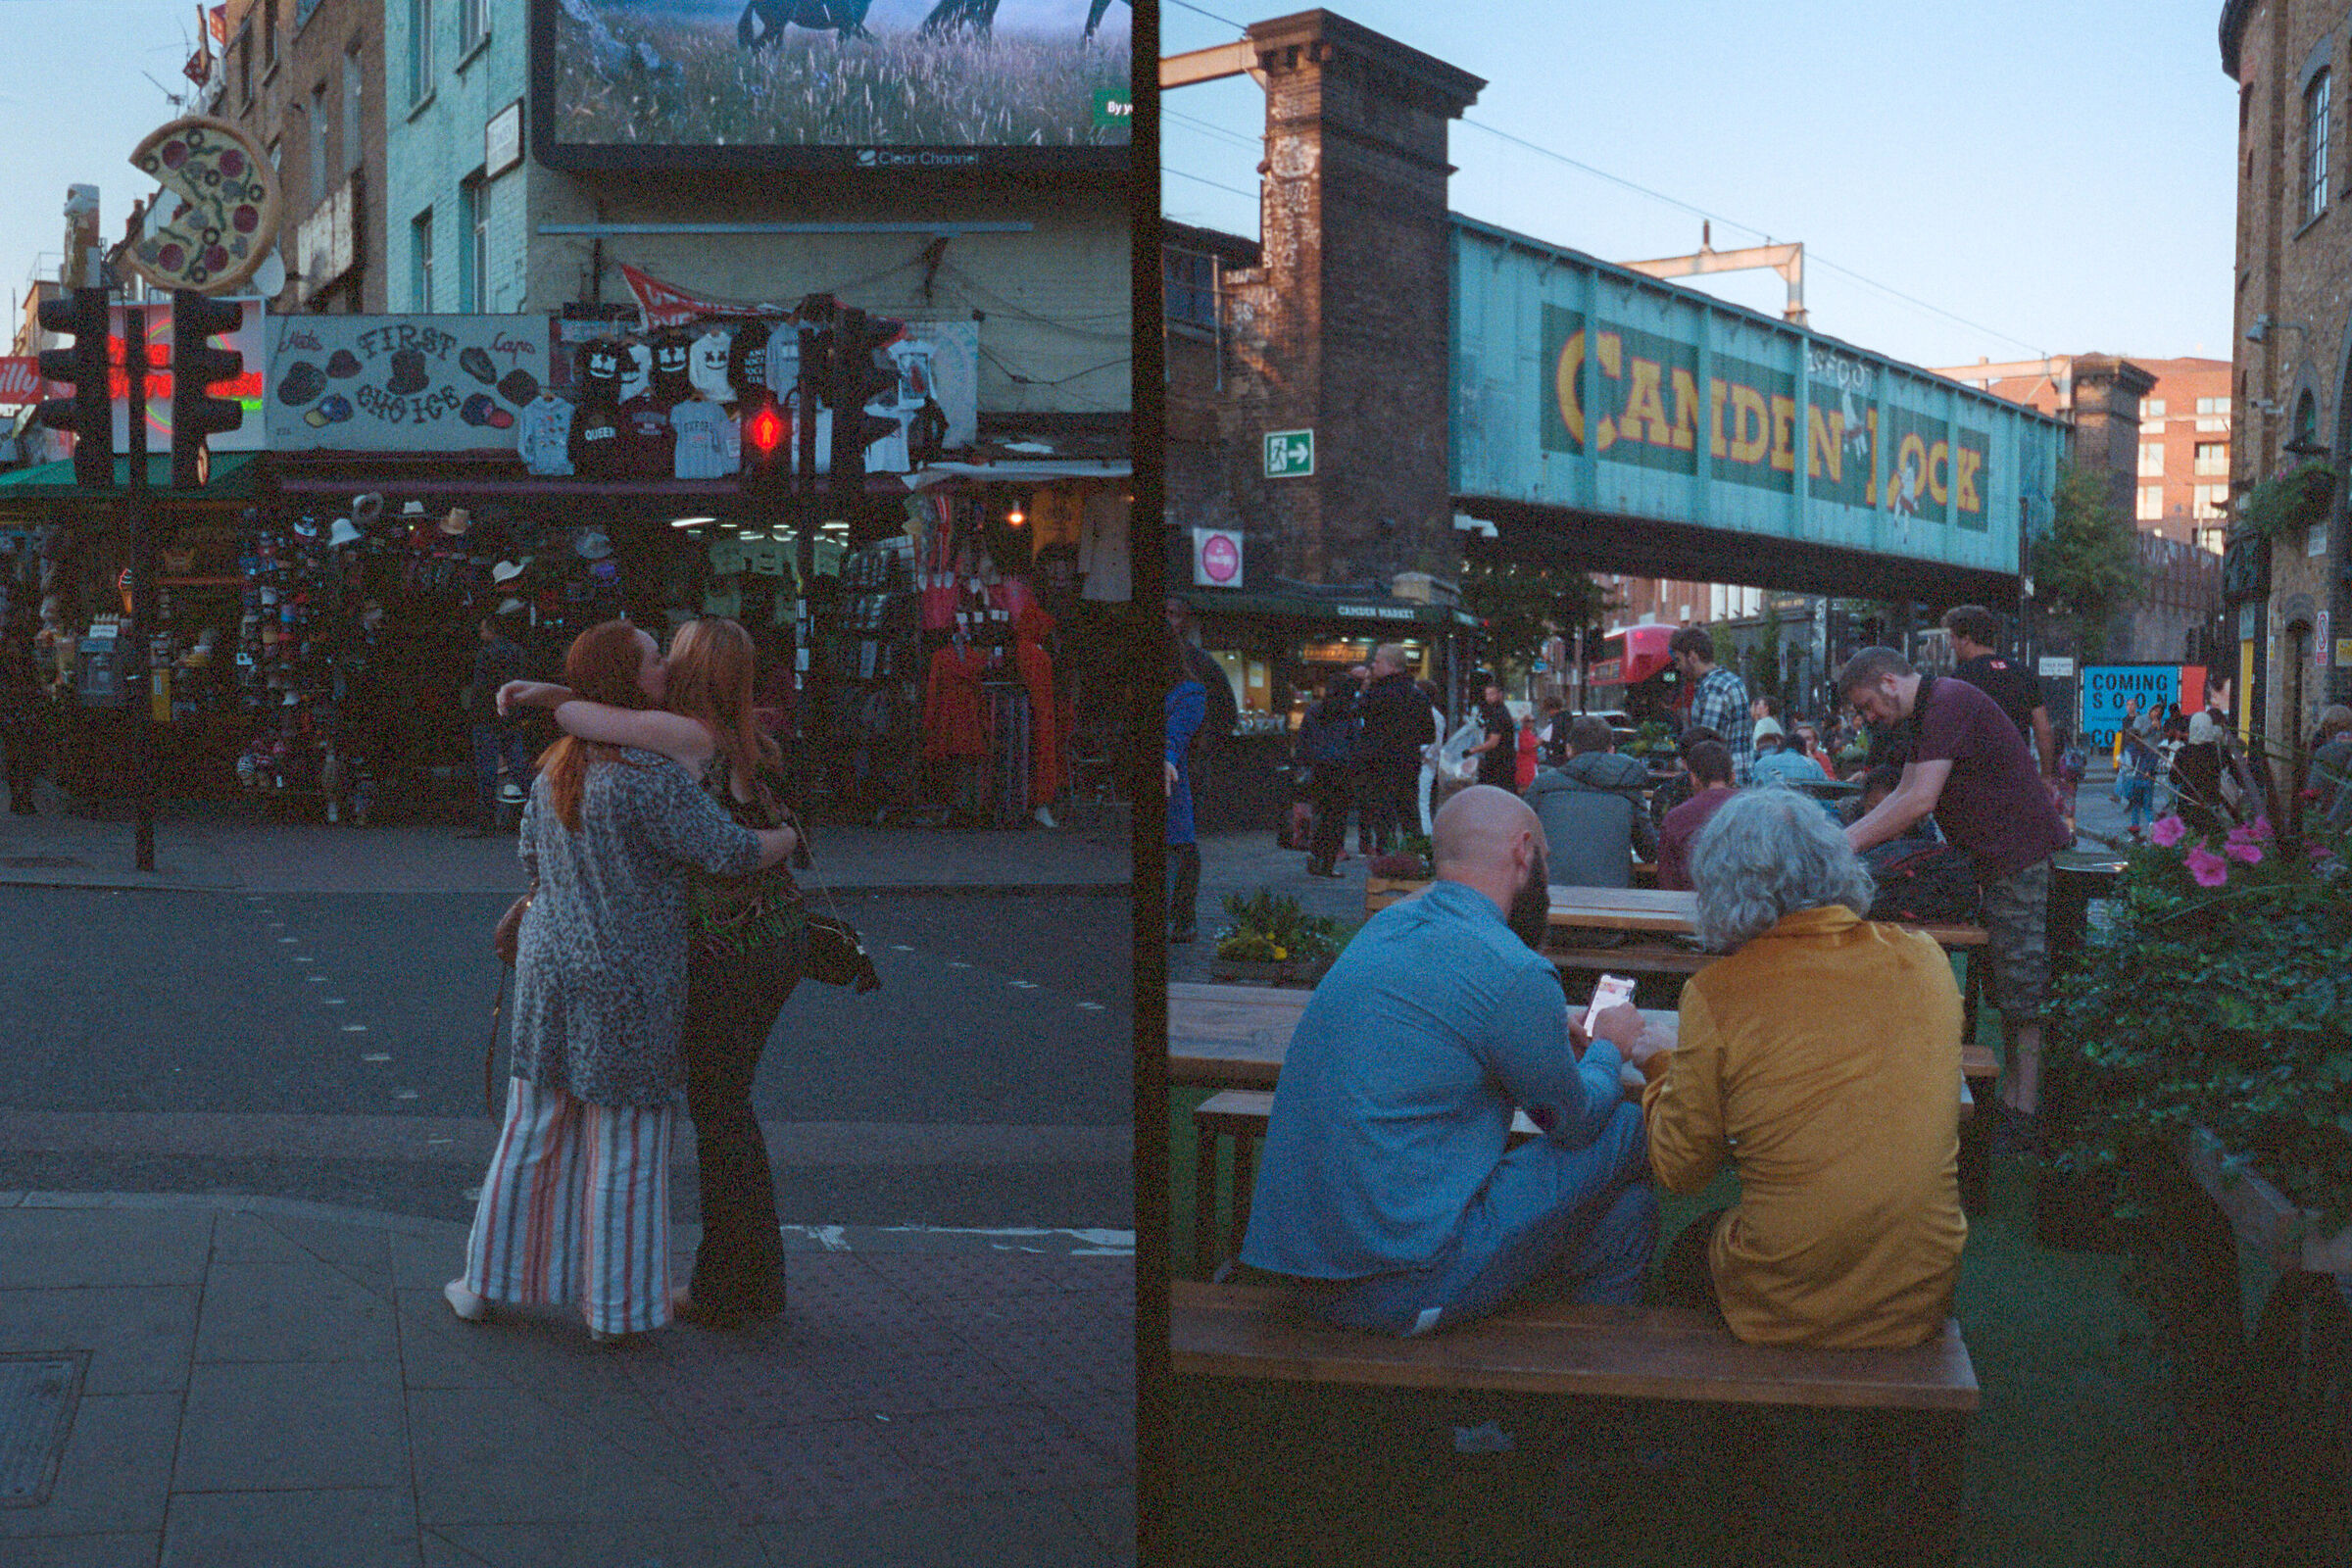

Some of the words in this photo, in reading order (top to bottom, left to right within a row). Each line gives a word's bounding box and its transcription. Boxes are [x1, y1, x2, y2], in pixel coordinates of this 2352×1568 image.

[1107, 100, 1122, 116] By
[879, 152, 916, 166] Clear
[919, 152, 979, 166] Channel
[358, 323, 457, 361] FIRST
[492, 330, 536, 365] Caps
[0, 363, 39, 401] illy
[356, 383, 463, 424] CHOICE
[1556, 329, 1844, 483] CAMDEN
[584, 426, 616, 441] QUEEN
[1866, 407, 1981, 513] LOCK
[1338, 604, 1377, 617] CAMDEN
[1378, 606, 1415, 619] MARKET
[2091, 673, 2168, 691] COMING
[2091, 692, 2168, 710] SOON
[2091, 728, 2116, 746] CO
